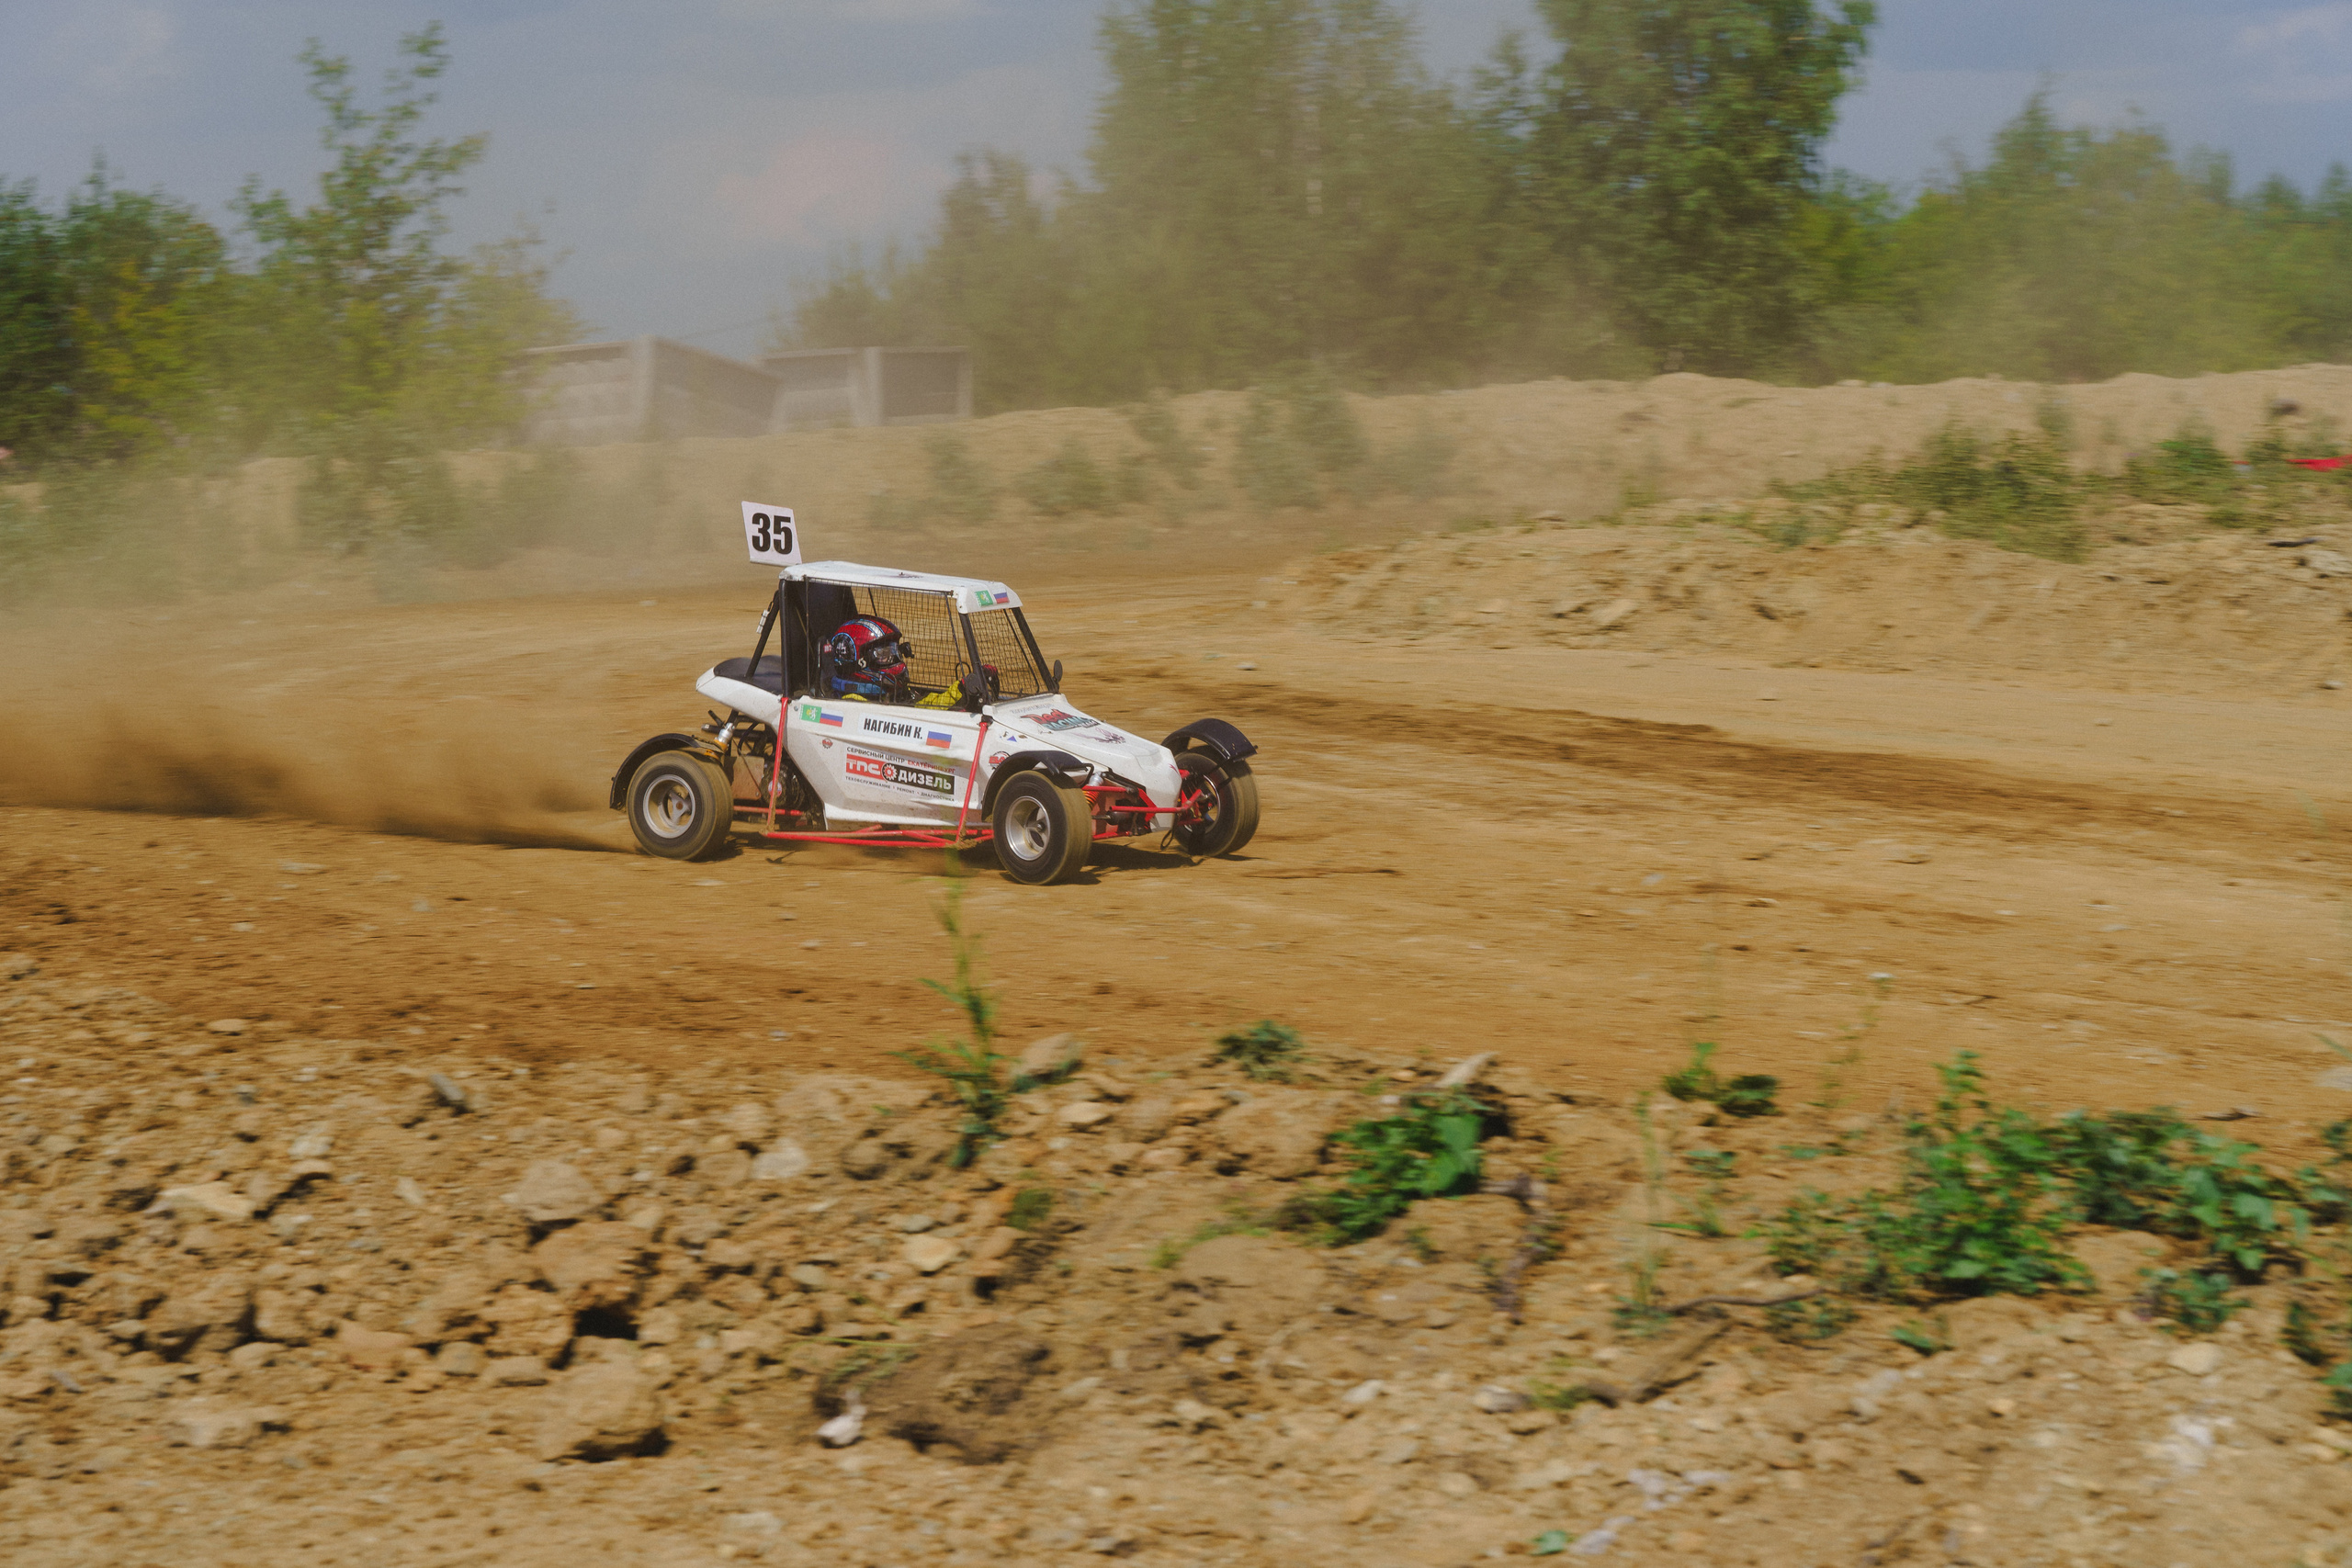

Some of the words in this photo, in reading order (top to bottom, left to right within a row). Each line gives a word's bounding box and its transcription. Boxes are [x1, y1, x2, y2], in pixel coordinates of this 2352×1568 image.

[752, 513, 793, 555] 35
[864, 718, 912, 739] НАГИБИН
[913, 727, 923, 739] К.
[846, 746, 884, 759] СЕРВИСНЫЙ
[885, 753, 905, 763] ЦЕНТР
[846, 758, 881, 775] ТПС
[898, 769, 952, 790] ДИЗЕЛЬ
